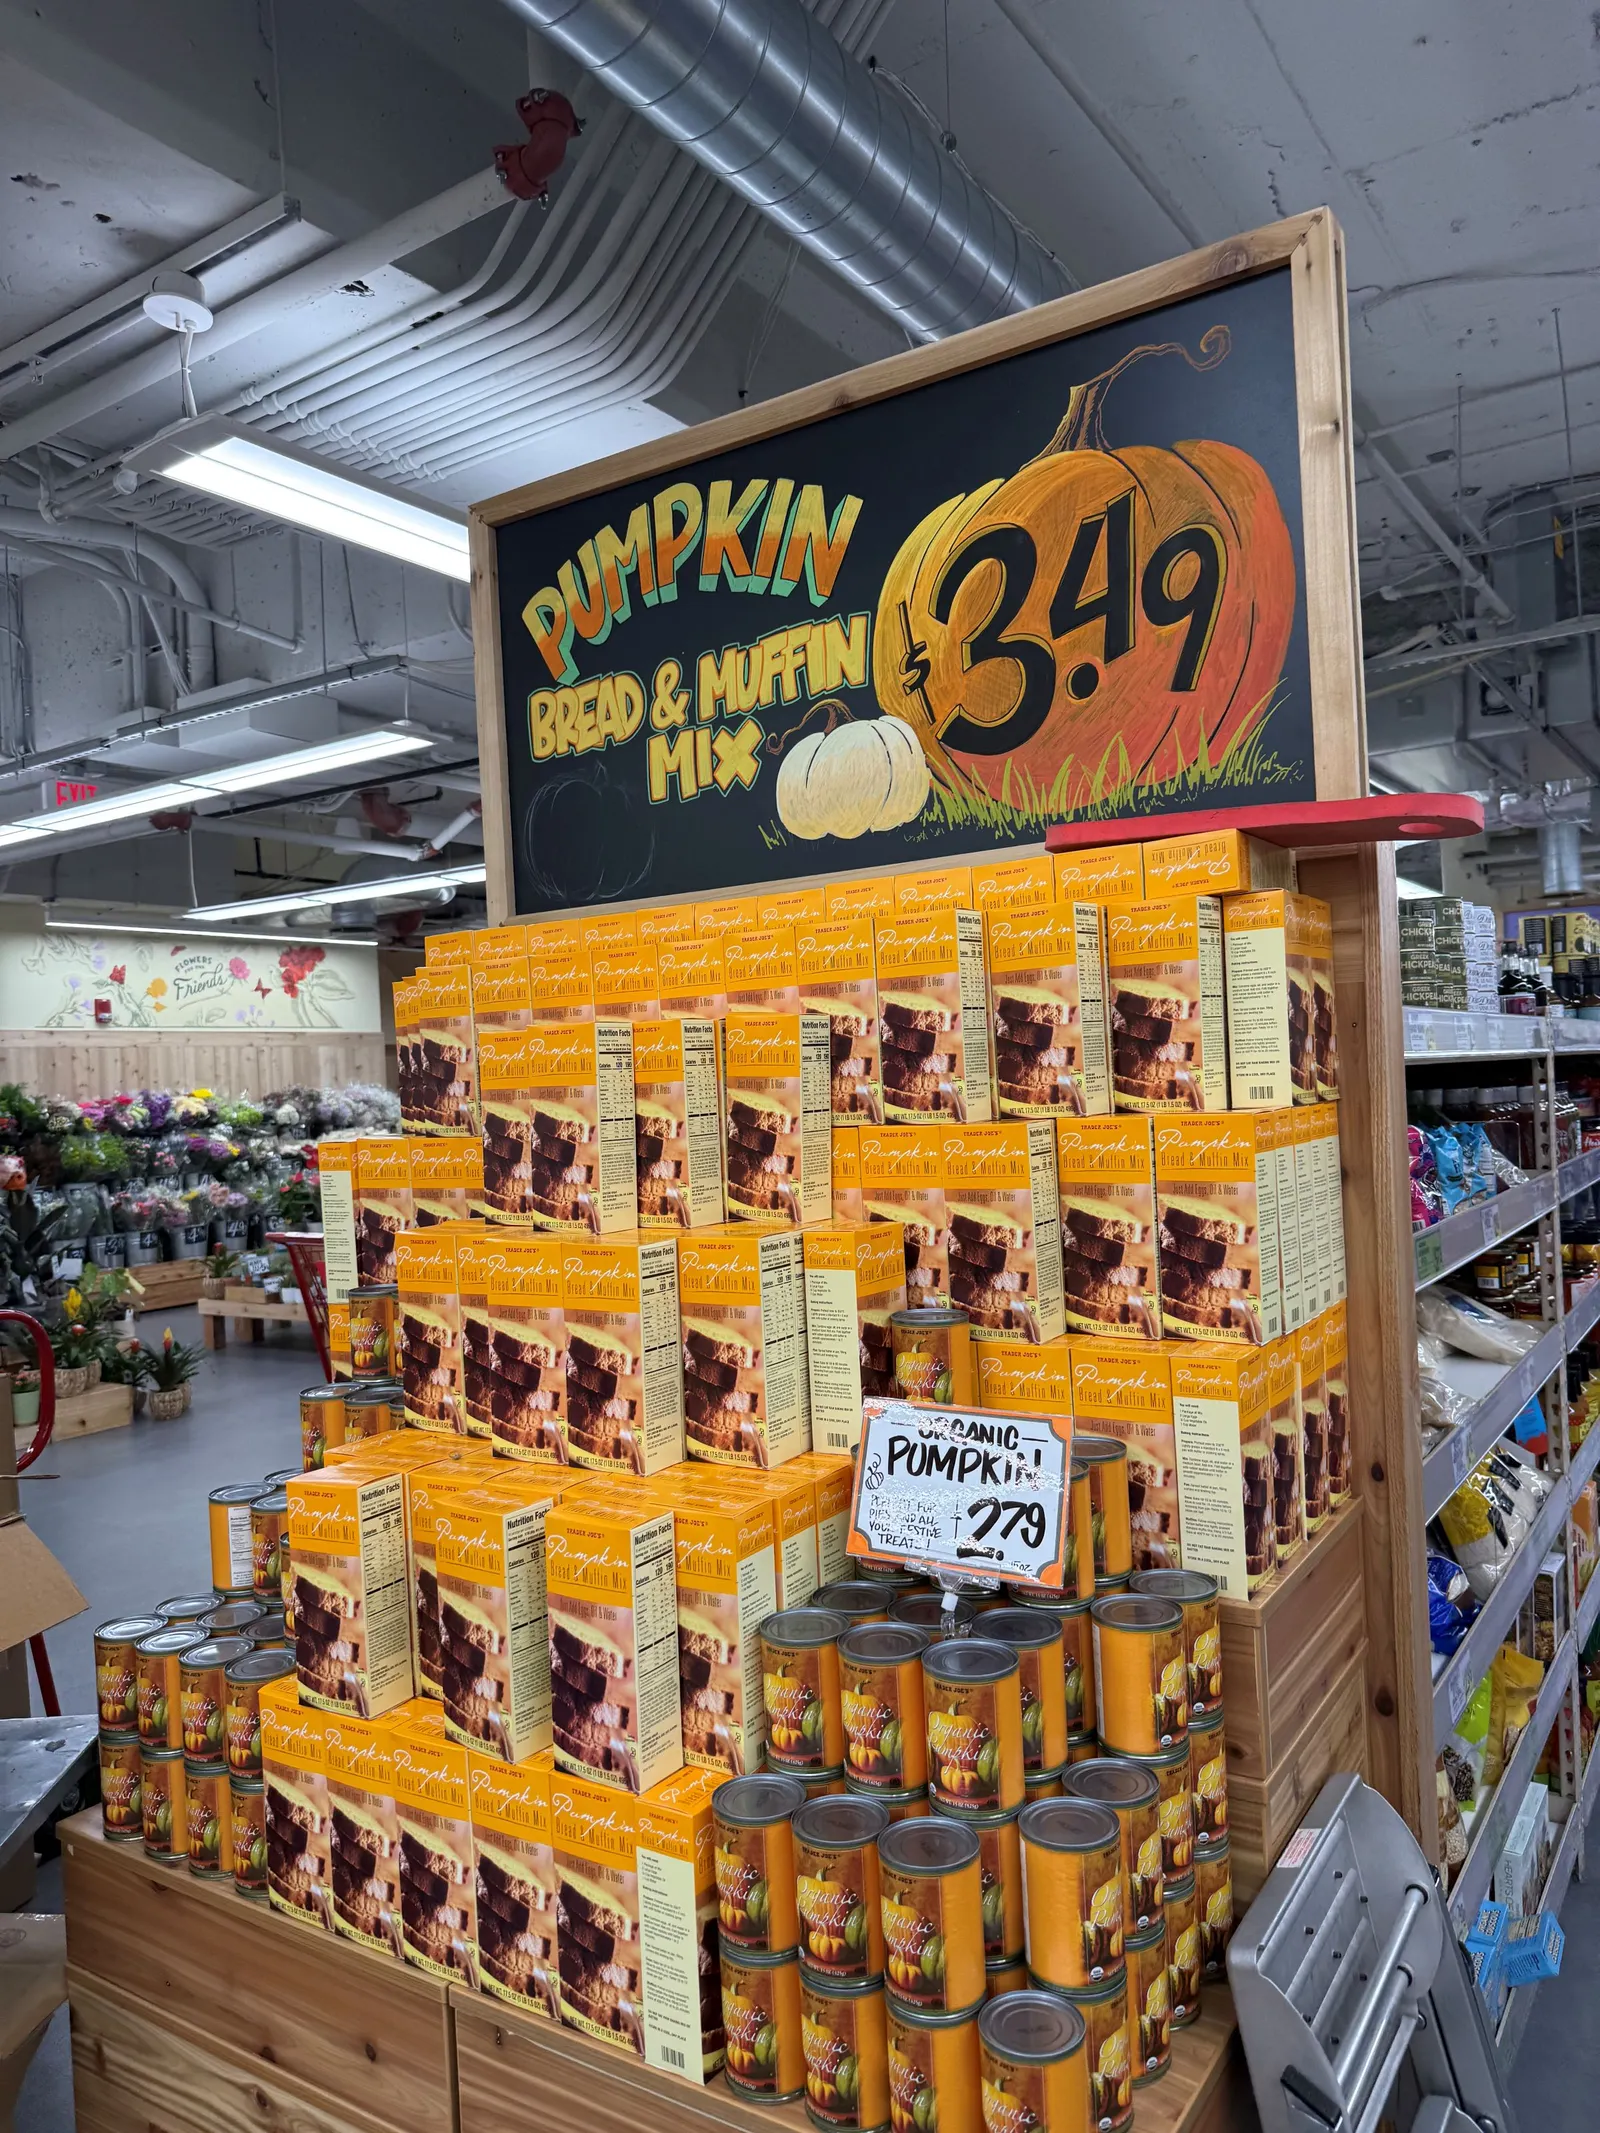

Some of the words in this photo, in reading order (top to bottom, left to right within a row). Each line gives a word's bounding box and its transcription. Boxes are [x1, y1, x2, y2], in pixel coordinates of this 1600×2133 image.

[522, 478, 863, 685] PUMPKIN
[528, 671, 646, 762] BREAD
[651, 658, 691, 730] &
[696, 612, 871, 722] MUFFIN
[647, 716, 766, 804] MIX
[1149, 847, 1231, 881] Pumpkin
[877, 926, 954, 959] Pumpkin
[991, 919, 1072, 952] Pumpkin
[1110, 913, 1194, 946] Pumpkin
[1113, 937, 1134, 952] Bread
[1148, 933, 1173, 949] Muffin
[1178, 932, 1192, 946] Mix
[175, 956, 212, 973] FLOWERS
[798, 934, 870, 966] Pumpkin
[173, 963, 228, 1001] Friends
[594, 960, 654, 988] Pumpkin
[529, 1039, 593, 1069] Pumpkin
[728, 1029, 797, 1059] Pumpkin
[730, 1050, 747, 1063] Bread
[758, 1050, 779, 1063] Muffin
[783, 1050, 795, 1063] Mix
[944, 1139, 1026, 1171] Pumpkin
[1060, 1133, 1146, 1165] Pumpkin
[1158, 1129, 1251, 1163] Pumpkin
[1161, 1152, 1184, 1166] Bread
[1200, 1152, 1228, 1166] Muffin
[1233, 1153, 1249, 1166] Mix
[488, 1255, 560, 1288] Pumpkin
[564, 1257, 636, 1292] Pumpkin
[680, 1252, 756, 1285] Pumpkin
[567, 1280, 585, 1295] Bread
[597, 1282, 619, 1296] Muffin
[622, 1283, 635, 1297] Mix
[981, 1358, 1066, 1392] Pumpkin
[1075, 1364, 1168, 1400] Pumpkin
[1078, 1387, 1102, 1403] Bread
[1116, 1390, 1144, 1407] Muffin
[1150, 1393, 1166, 1409] Mix
[918, 1417, 1019, 1451] ORGANIC
[888, 1435, 1042, 1491] PUMPKIN
[361, 1488, 385, 1502] Nutrition
[386, 1482, 400, 1494] Facts
[288, 1497, 356, 1533] Pumpkin
[507, 1514, 534, 1530] Nutrition
[869, 1520, 892, 1532] YOU
[634, 1528, 658, 1546] Nutrition
[658, 1522, 672, 1536] Facts
[547, 1535, 628, 1578] Pumpkin
[549, 1561, 569, 1581] Bread
[582, 1567, 607, 1588] Muffin
[612, 1572, 626, 1591] Mix
[261, 1709, 322, 1746] Pumpkin
[325, 1729, 392, 1768] Pumpkin
[393, 1750, 464, 1790] Pumpkin
[471, 1770, 548, 1812] Pumpkin
[474, 1794, 493, 1814] Bread
[505, 1803, 528, 1825] Muffin
[533, 1811, 546, 1830] Mix
[552, 1793, 635, 1837] Pumpkin
